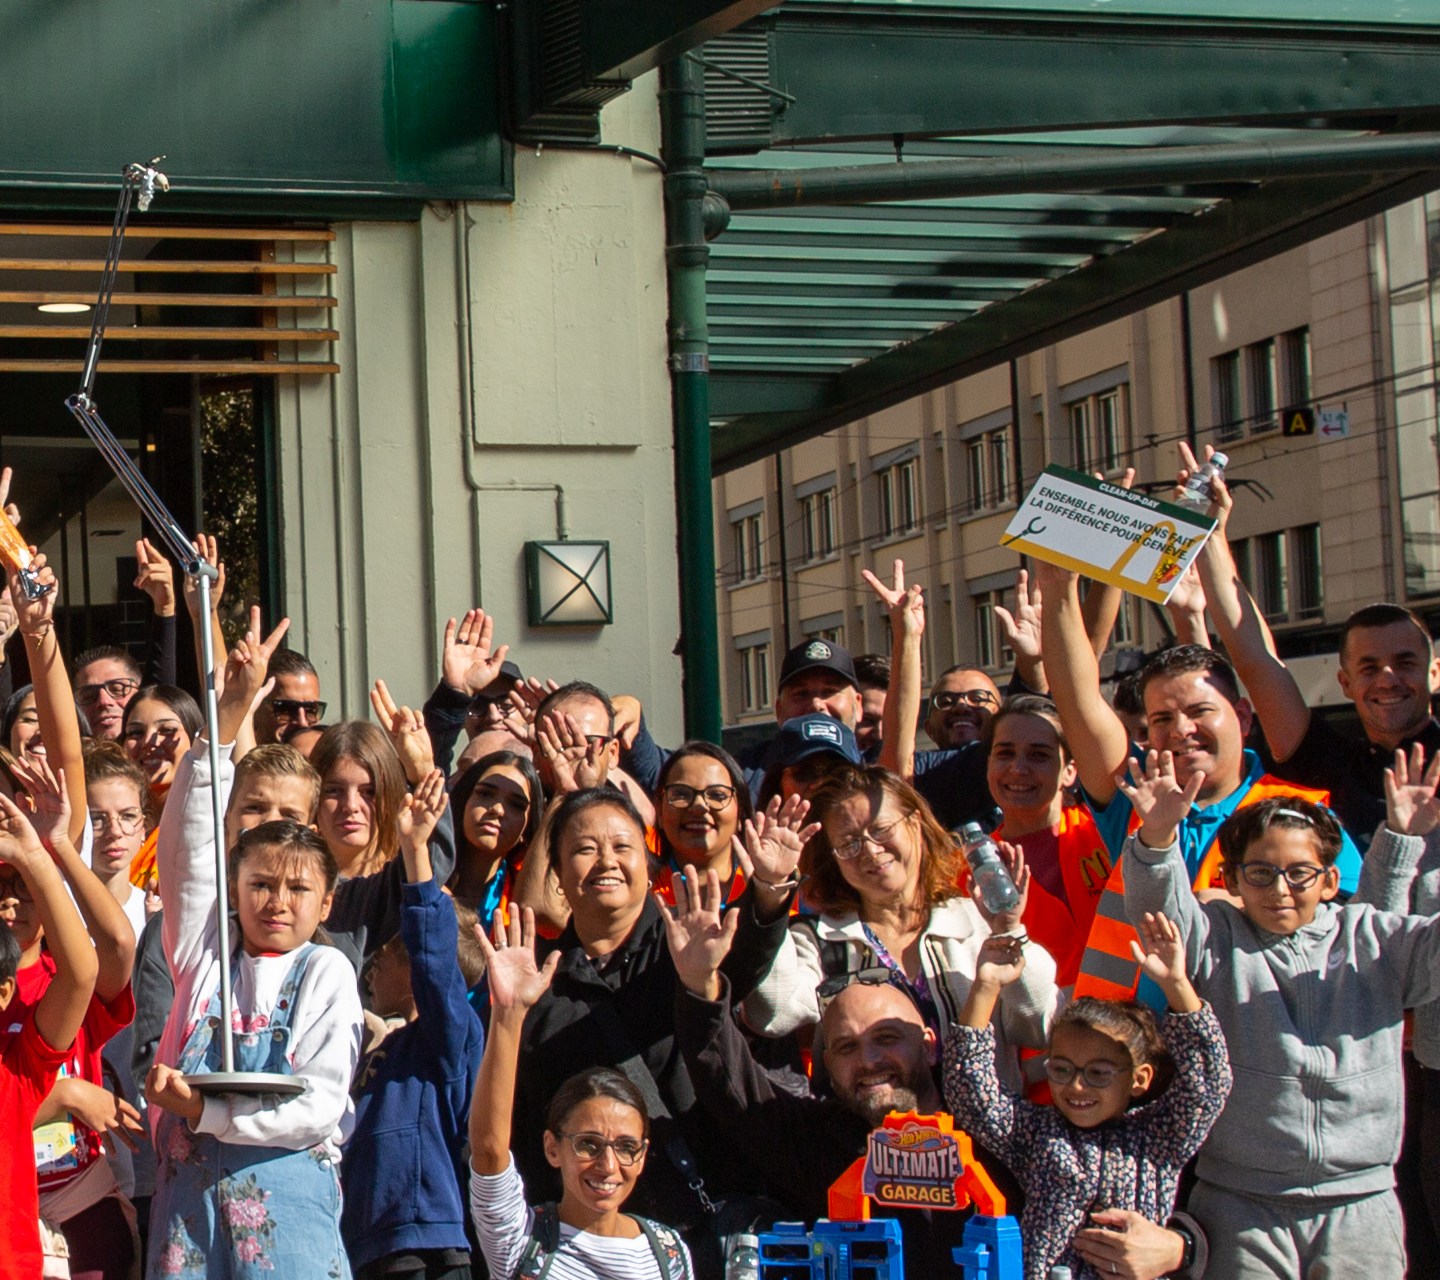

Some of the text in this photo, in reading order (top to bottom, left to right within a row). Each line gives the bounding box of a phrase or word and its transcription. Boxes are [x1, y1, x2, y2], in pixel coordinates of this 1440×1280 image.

[1289, 412, 1307, 433] A
[1099, 482, 1161, 510] CLEAN-UP-DAY
[1029, 496, 1045, 509] LA
[1044, 501, 1111, 533] DIFFÉRENCE
[1109, 525, 1143, 545] POUR
[1039, 486, 1196, 548] ENSEMBLE, NOUS AVONS FAIT
[871, 1138, 959, 1179] ULTIMATE
[881, 1184, 951, 1203] GARAGE
